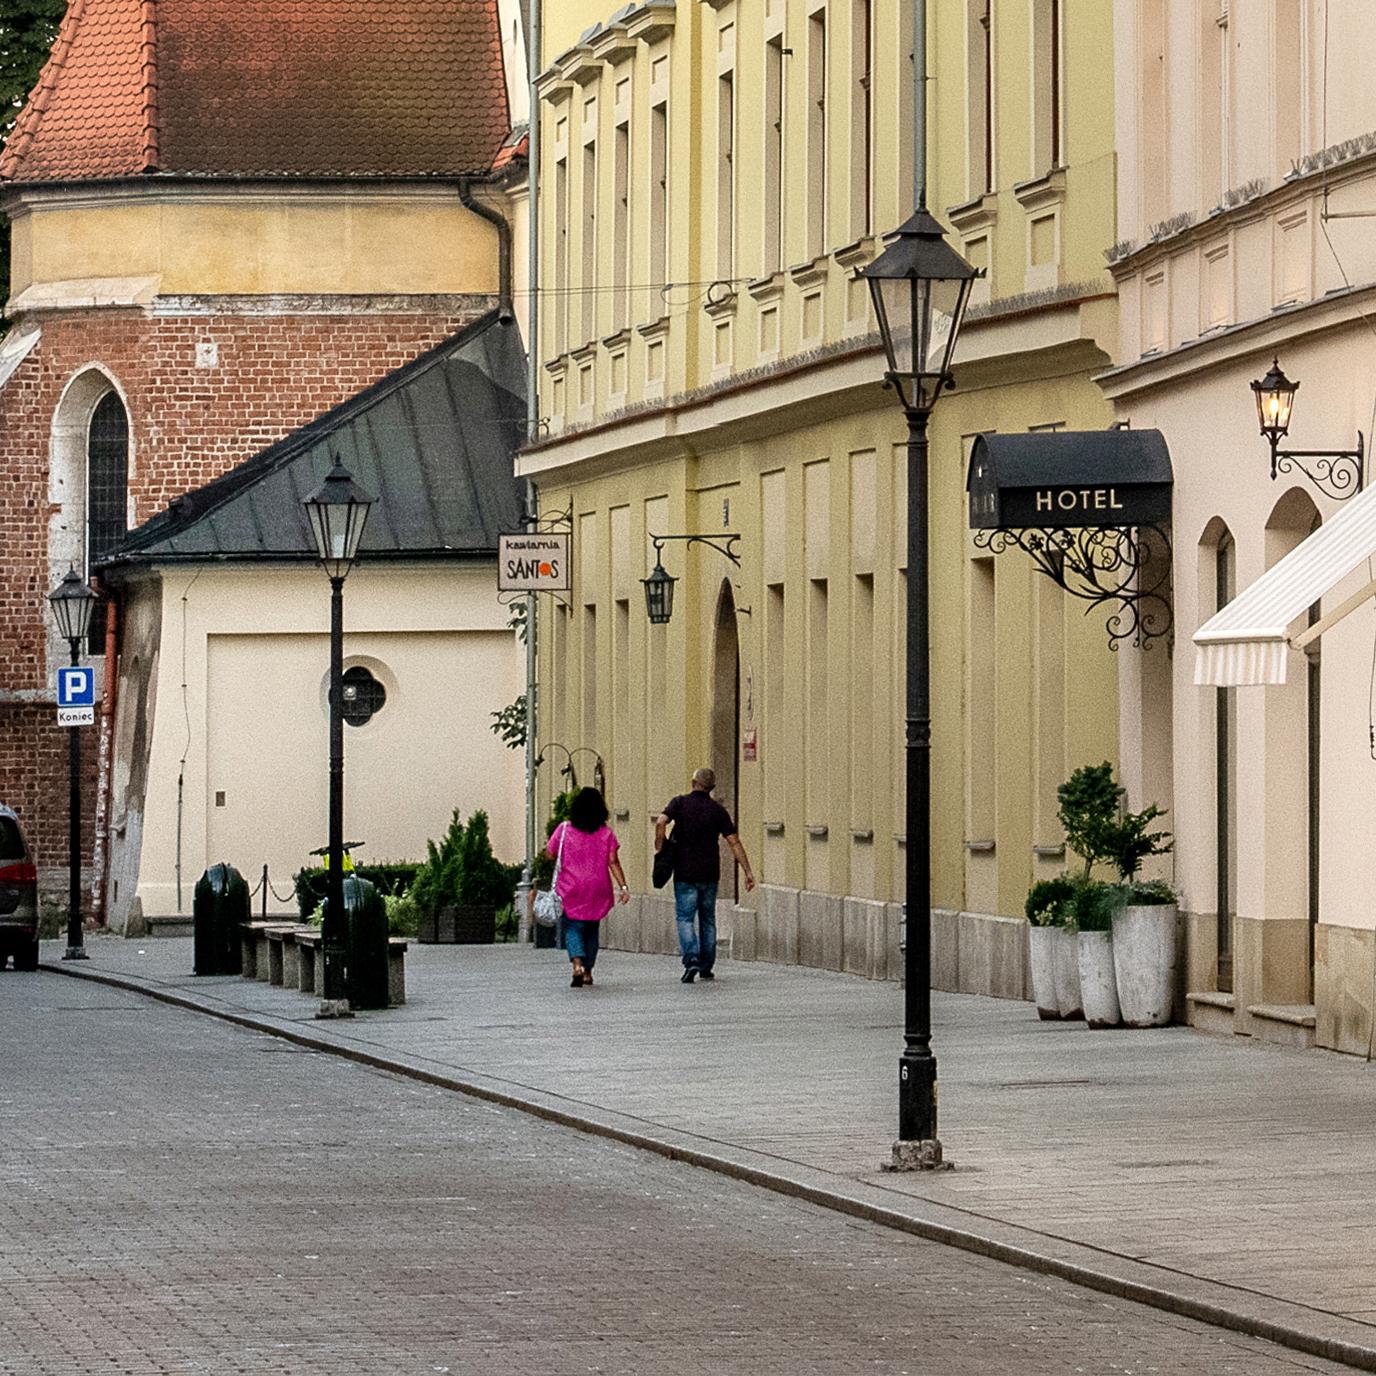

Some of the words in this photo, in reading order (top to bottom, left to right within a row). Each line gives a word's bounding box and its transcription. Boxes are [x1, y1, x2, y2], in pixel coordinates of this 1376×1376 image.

[1035, 488, 1124, 512] HOTEL
[506, 539, 561, 550] kawiarnia
[506, 557, 559, 580] SANTOS
[65, 671, 87, 702] P
[58, 712, 93, 722] Koniec
[901, 1064, 909, 1081] 6
